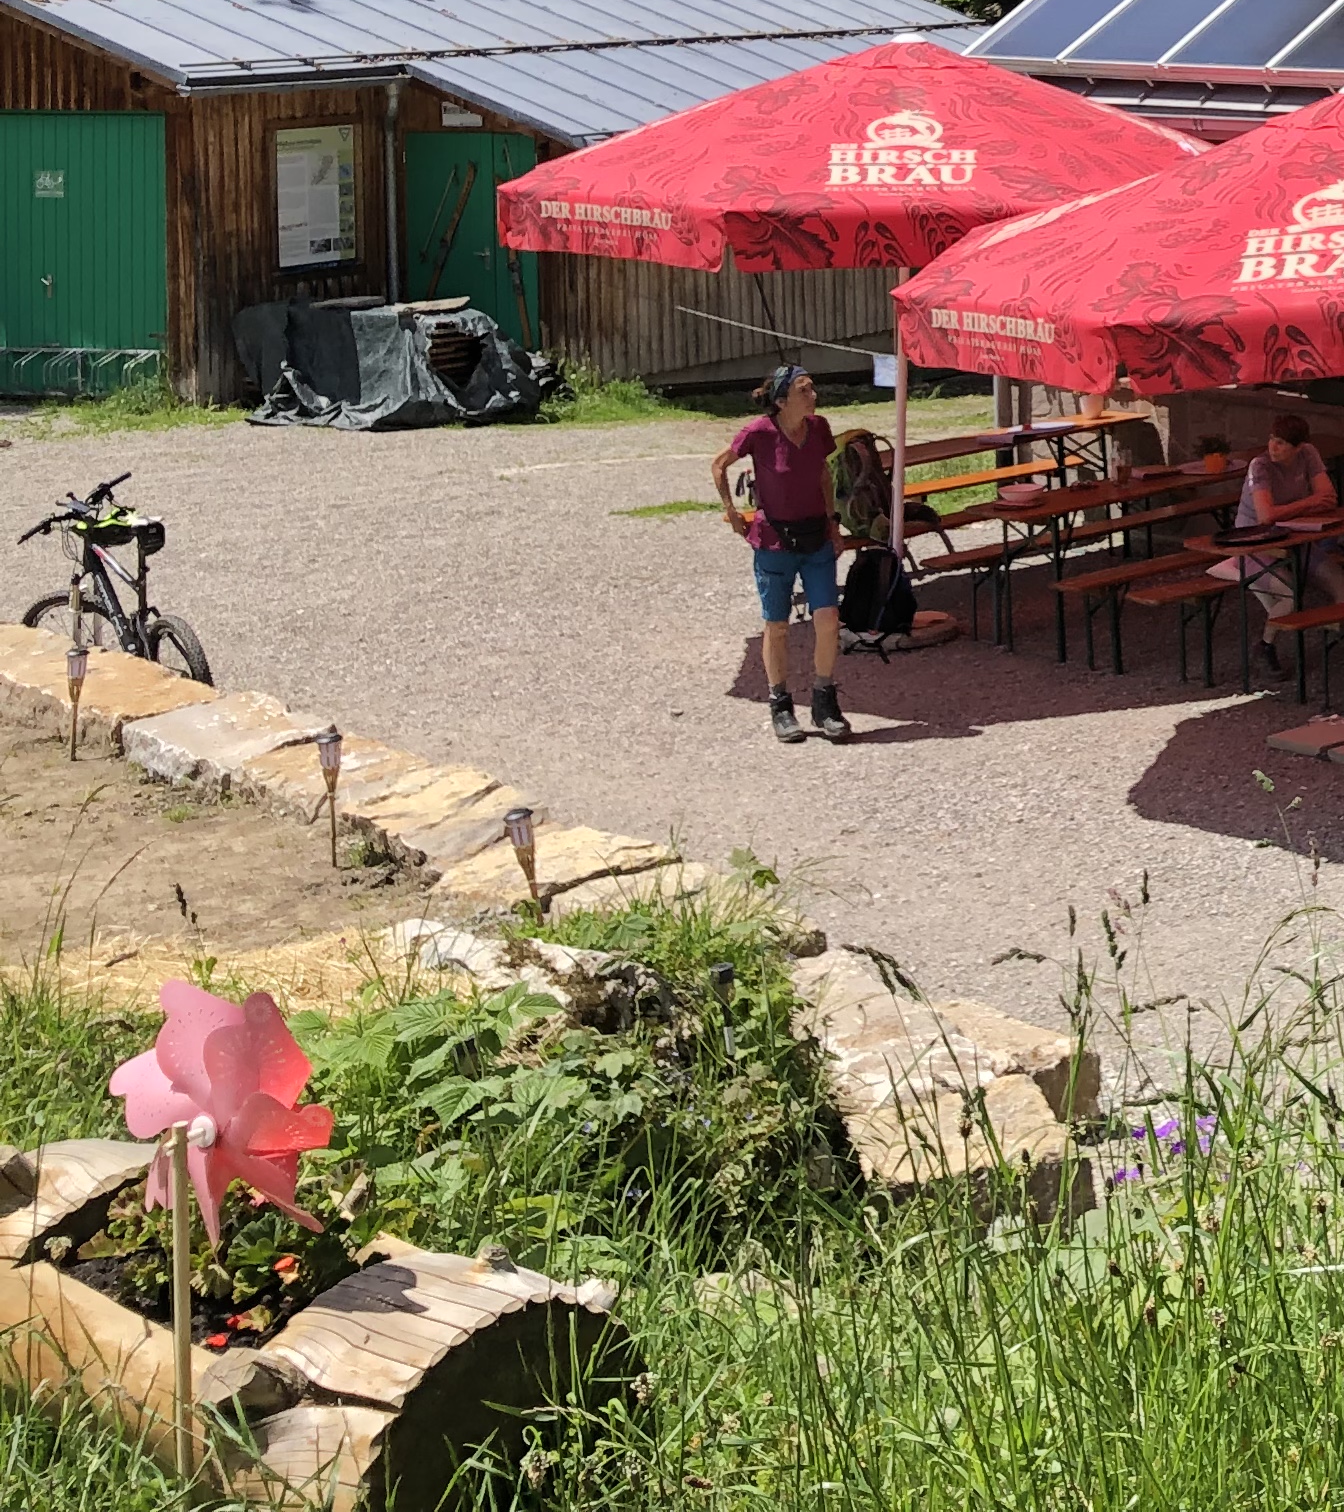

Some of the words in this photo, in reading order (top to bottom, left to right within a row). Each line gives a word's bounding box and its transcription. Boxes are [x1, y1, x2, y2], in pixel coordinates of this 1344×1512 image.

[828, 149, 978, 164] HIRSCH
[825, 164, 977, 185] BRÄU
[540, 200, 571, 219] DER
[574, 203, 672, 230] HIRSCHBRÄU
[931, 309, 959, 330] DER
[962, 311, 1056, 344] HIRSCHBRÄU
